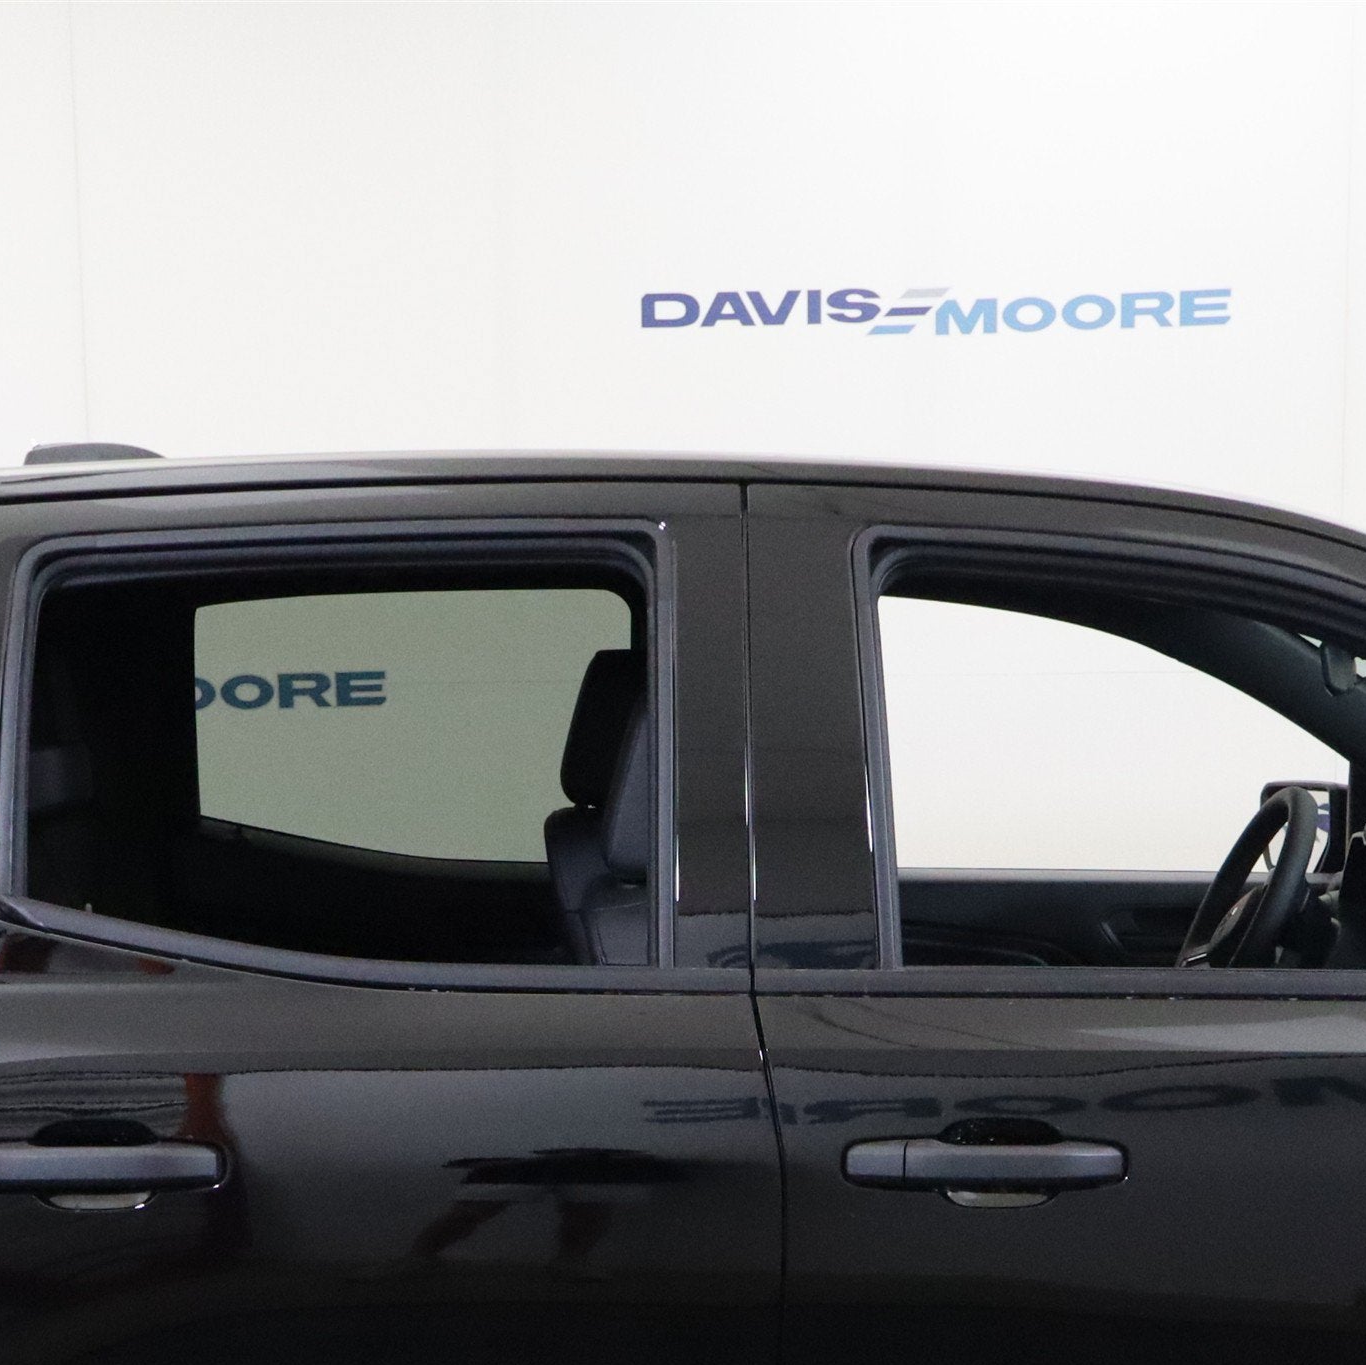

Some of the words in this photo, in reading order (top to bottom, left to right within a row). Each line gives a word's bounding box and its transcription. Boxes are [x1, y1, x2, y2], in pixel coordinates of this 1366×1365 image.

[640, 287, 882, 329] DAVIS
[934, 287, 1232, 336] MOORE
[195, 670, 387, 710] ORE
